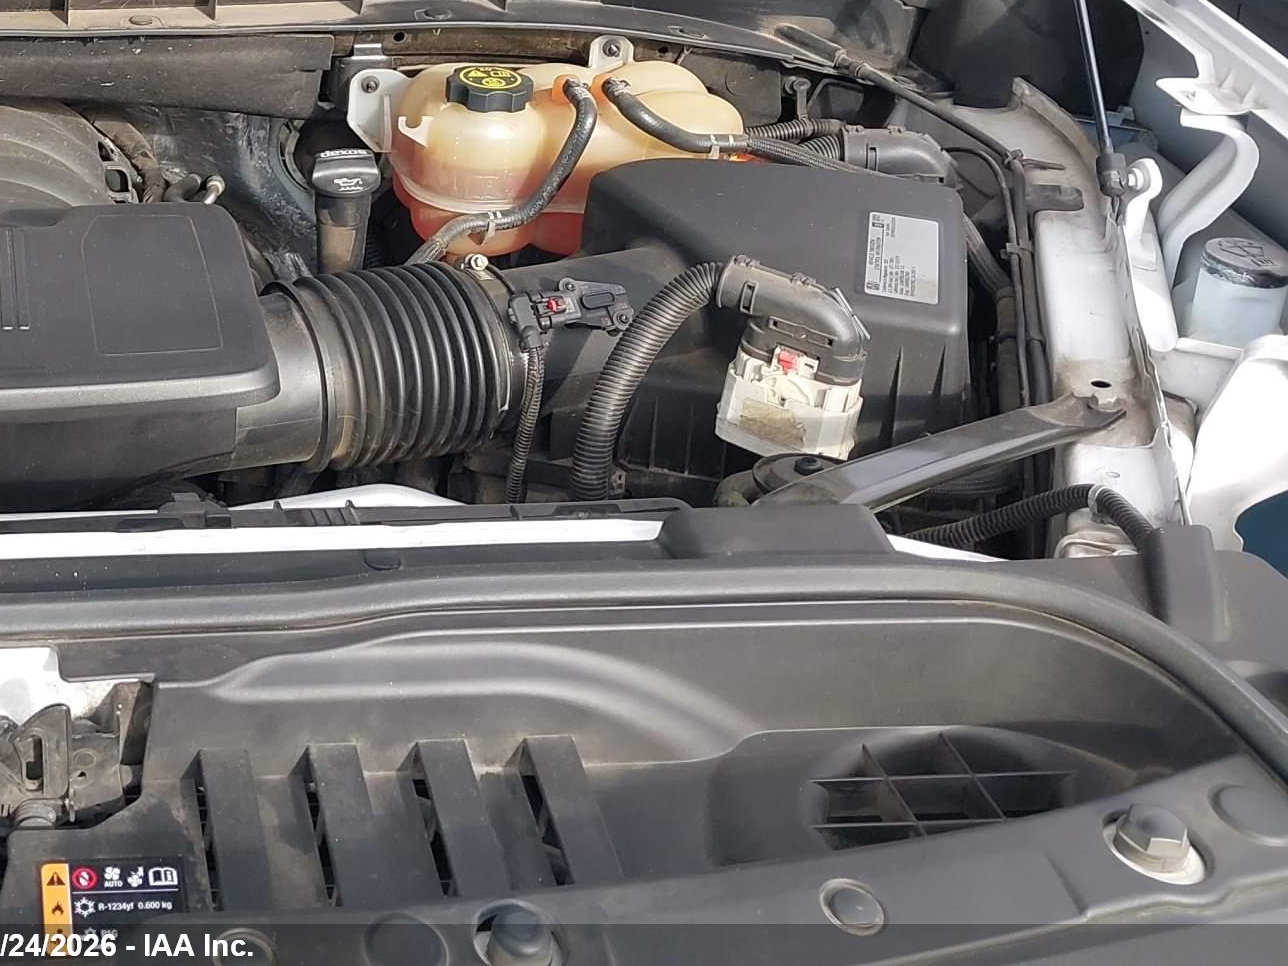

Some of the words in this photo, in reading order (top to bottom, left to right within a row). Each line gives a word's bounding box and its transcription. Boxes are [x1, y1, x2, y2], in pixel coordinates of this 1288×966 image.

[98, 901, 134, 912] R-1234yf
[137, 901, 161, 910] 0.600
[161, 901, 173, 911] kg
